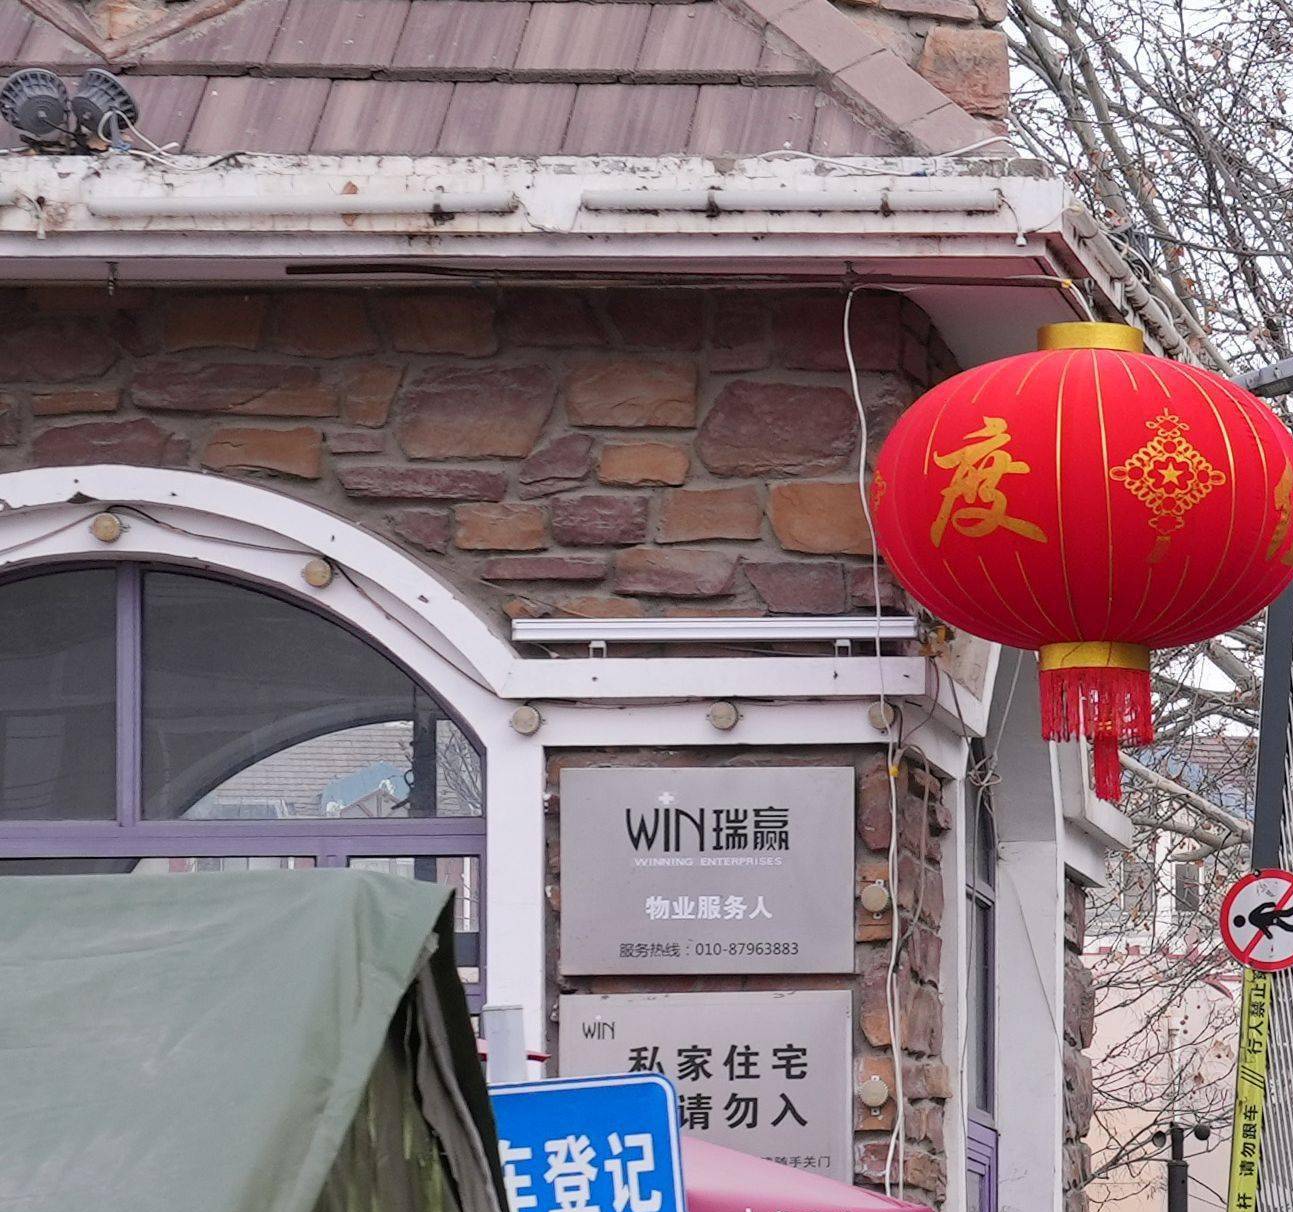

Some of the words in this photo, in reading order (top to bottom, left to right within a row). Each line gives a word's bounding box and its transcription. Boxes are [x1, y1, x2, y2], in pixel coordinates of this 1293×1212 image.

[930, 415, 1047, 548] 度
[625, 807, 705, 852] WIN
[712, 806, 790, 851] 瑞赢
[634, 857, 694, 867] WINNING
[700, 856, 783, 866] ENTERPRISES
[645, 895, 773, 920] 物业服务人
[582, 1021, 616, 1040] WIN
[628, 1044, 808, 1081] 私家住宅
[1238, 1103, 1260, 1177] 请勿跟车
